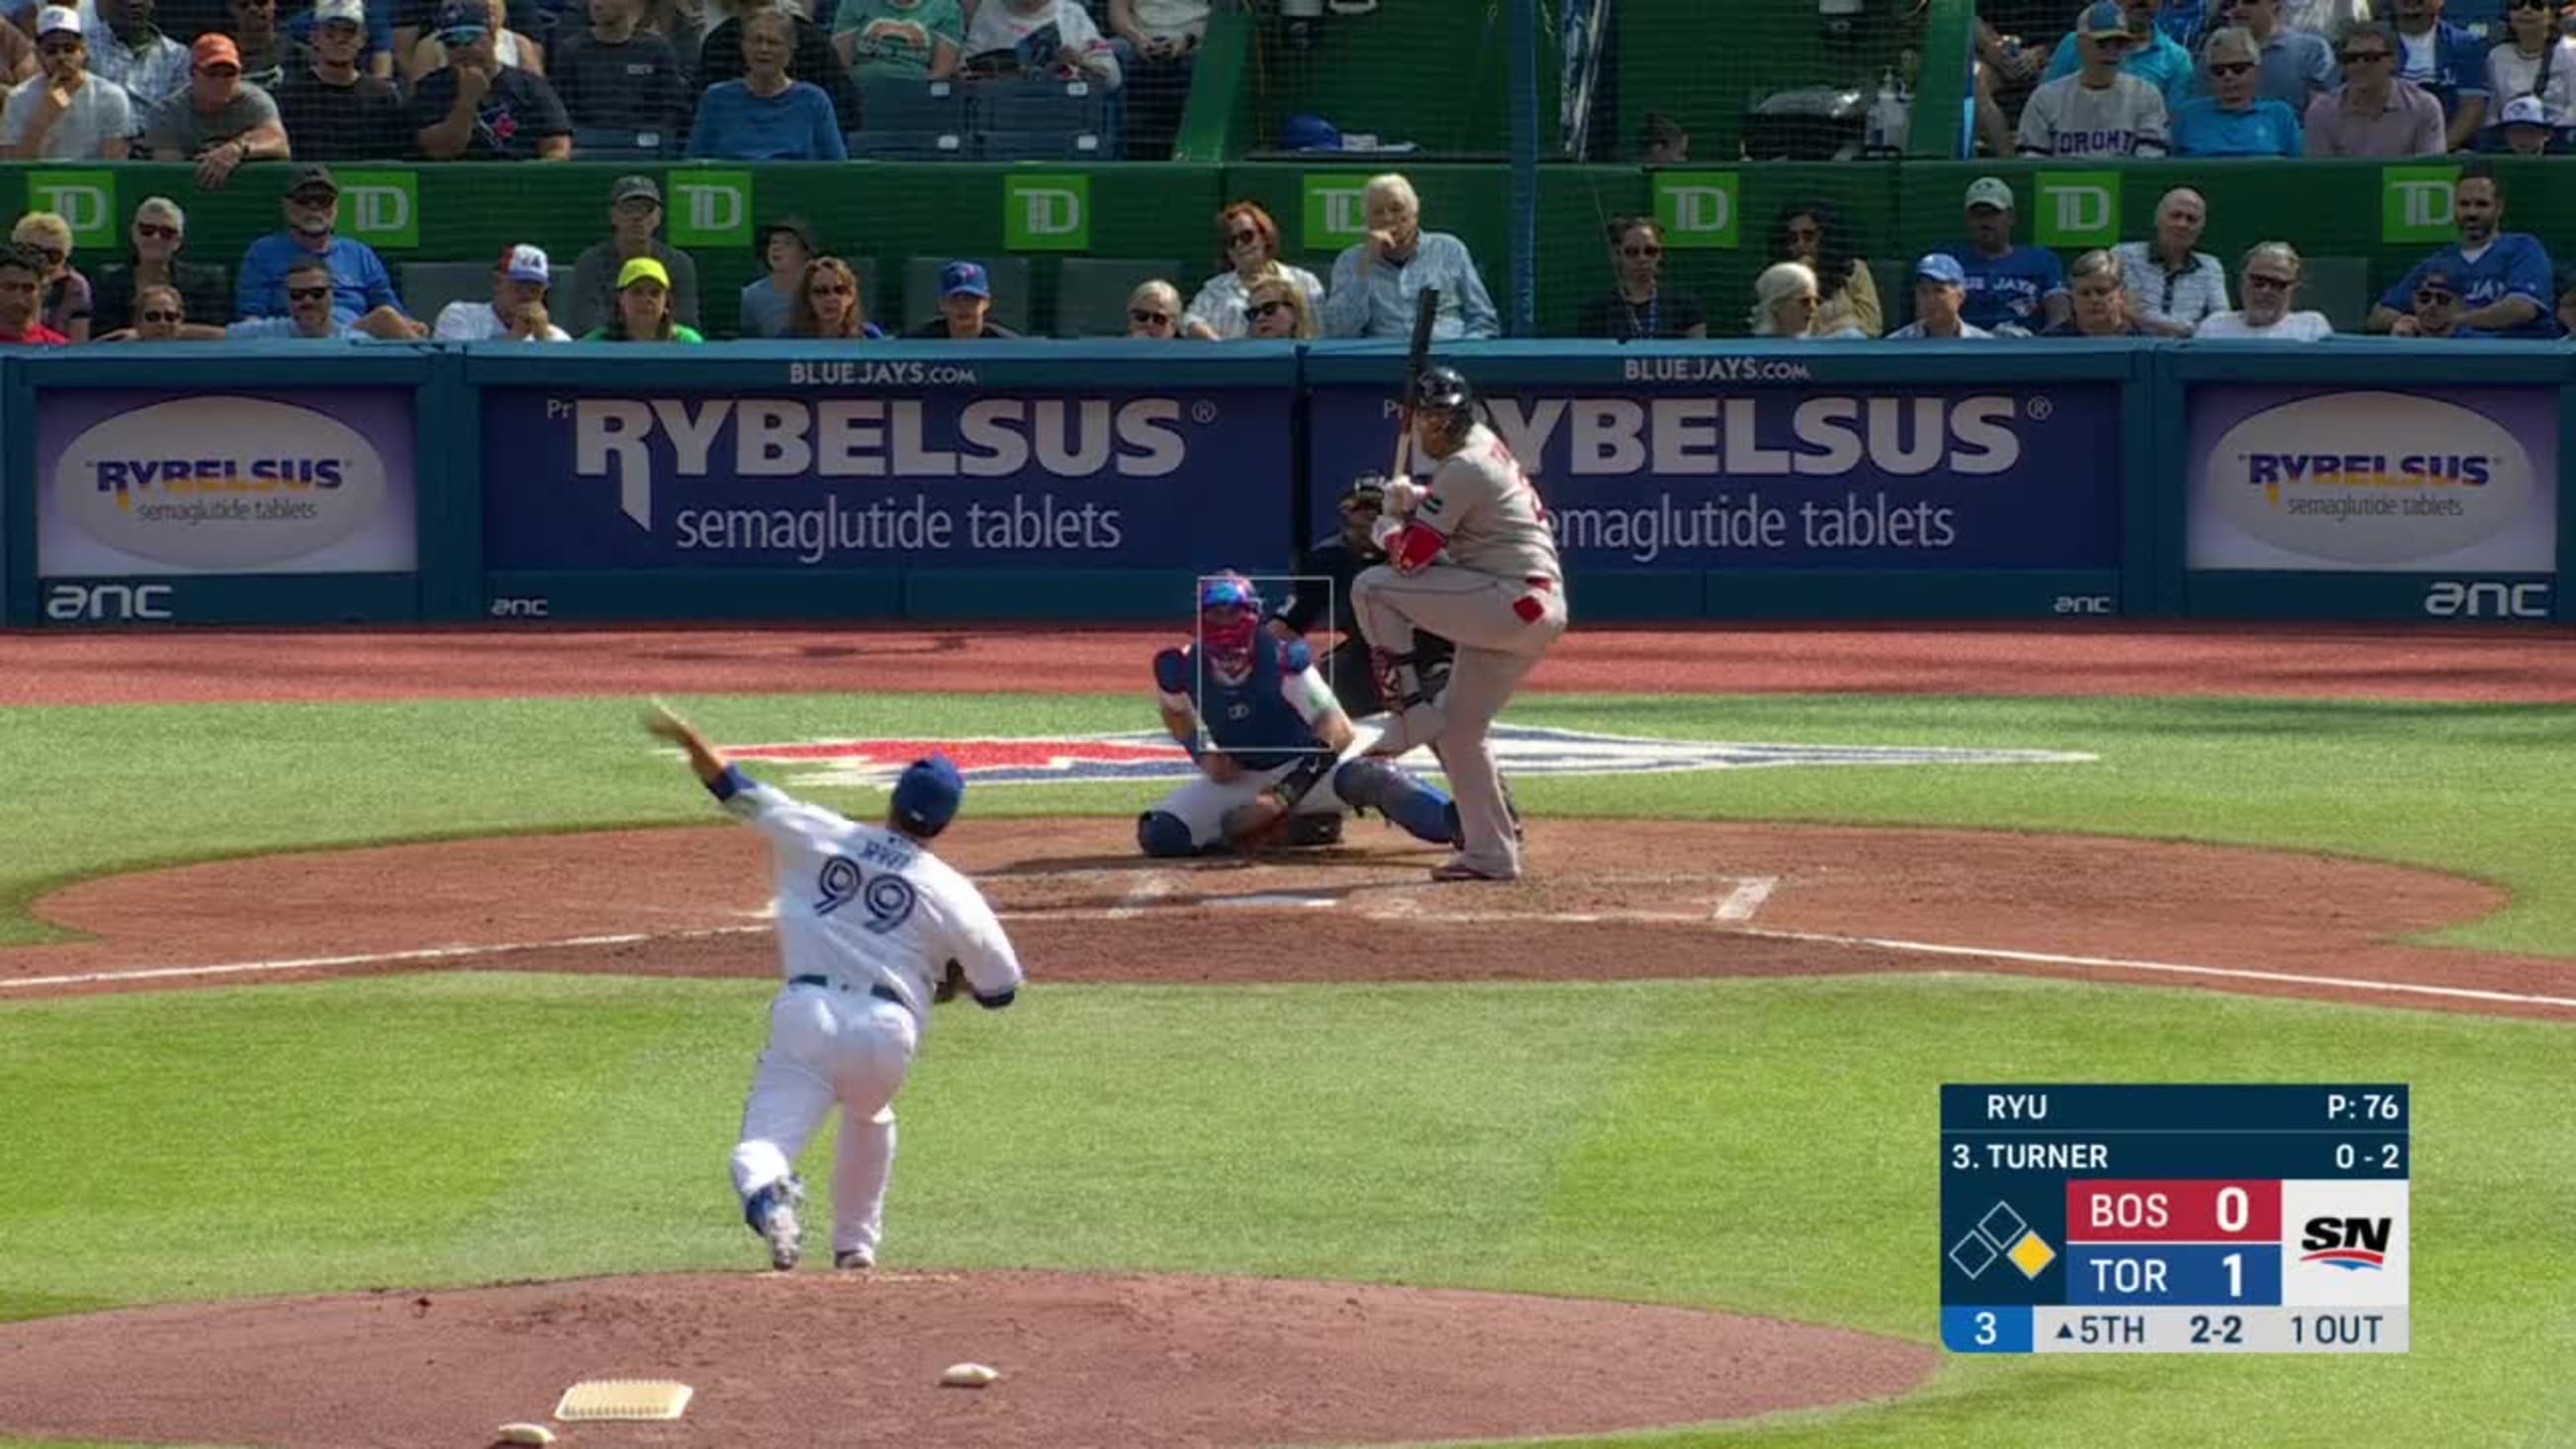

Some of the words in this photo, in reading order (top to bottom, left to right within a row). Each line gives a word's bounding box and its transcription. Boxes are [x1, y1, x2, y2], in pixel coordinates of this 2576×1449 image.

[37, 185, 107, 230] TD
[339, 185, 410, 231] TD
[676, 184, 742, 230] TD
[1013, 188, 1080, 234] TD
[1661, 186, 1729, 231] TD
[2044, 186, 2111, 231] TD
[2389, 181, 2456, 226] TD
[790, 362, 977, 384] BLUEJAYS.COM
[1624, 357, 1811, 380] BLUEJAYS.COM
[677, 495, 951, 563] semaglutide
[968, 495, 1121, 548] tablets
[1801, 493, 1955, 547] tablets
[812, 854, 917, 934] 99
